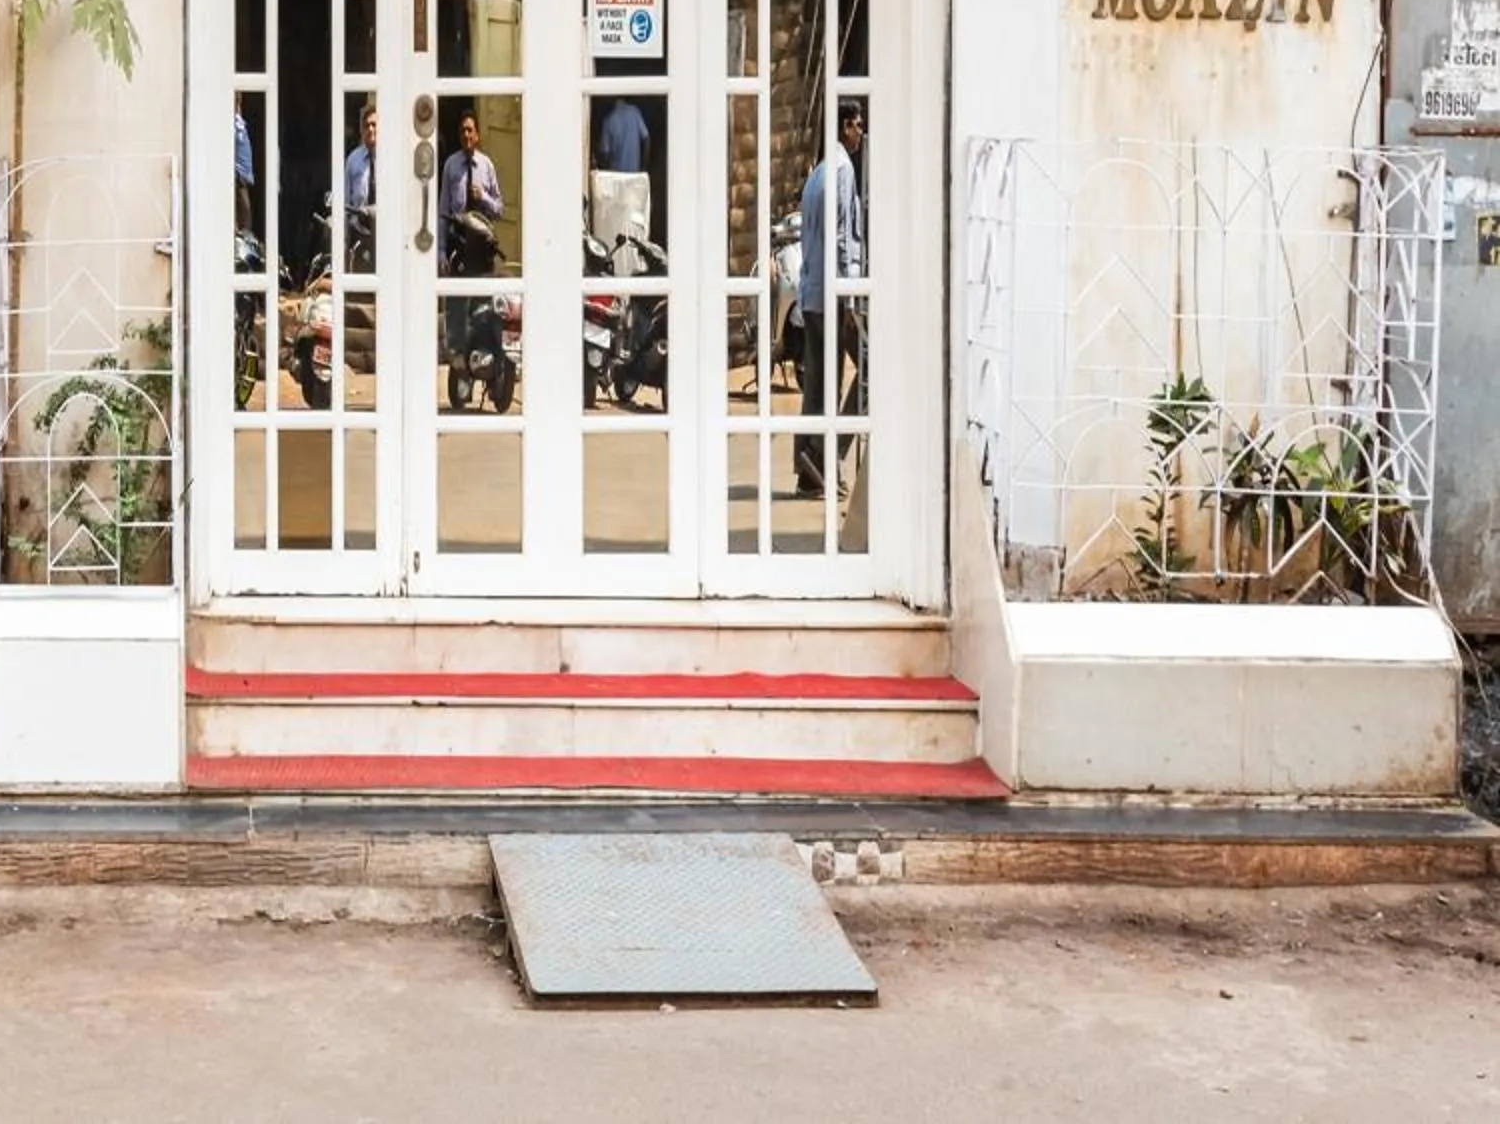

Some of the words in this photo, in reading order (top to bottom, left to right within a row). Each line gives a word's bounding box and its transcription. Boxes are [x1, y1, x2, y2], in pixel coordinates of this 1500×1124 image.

[597, 8, 627, 19] WITHOUT
[606, 20, 624, 31] FACE
[601, 33, 622, 43] MASK
